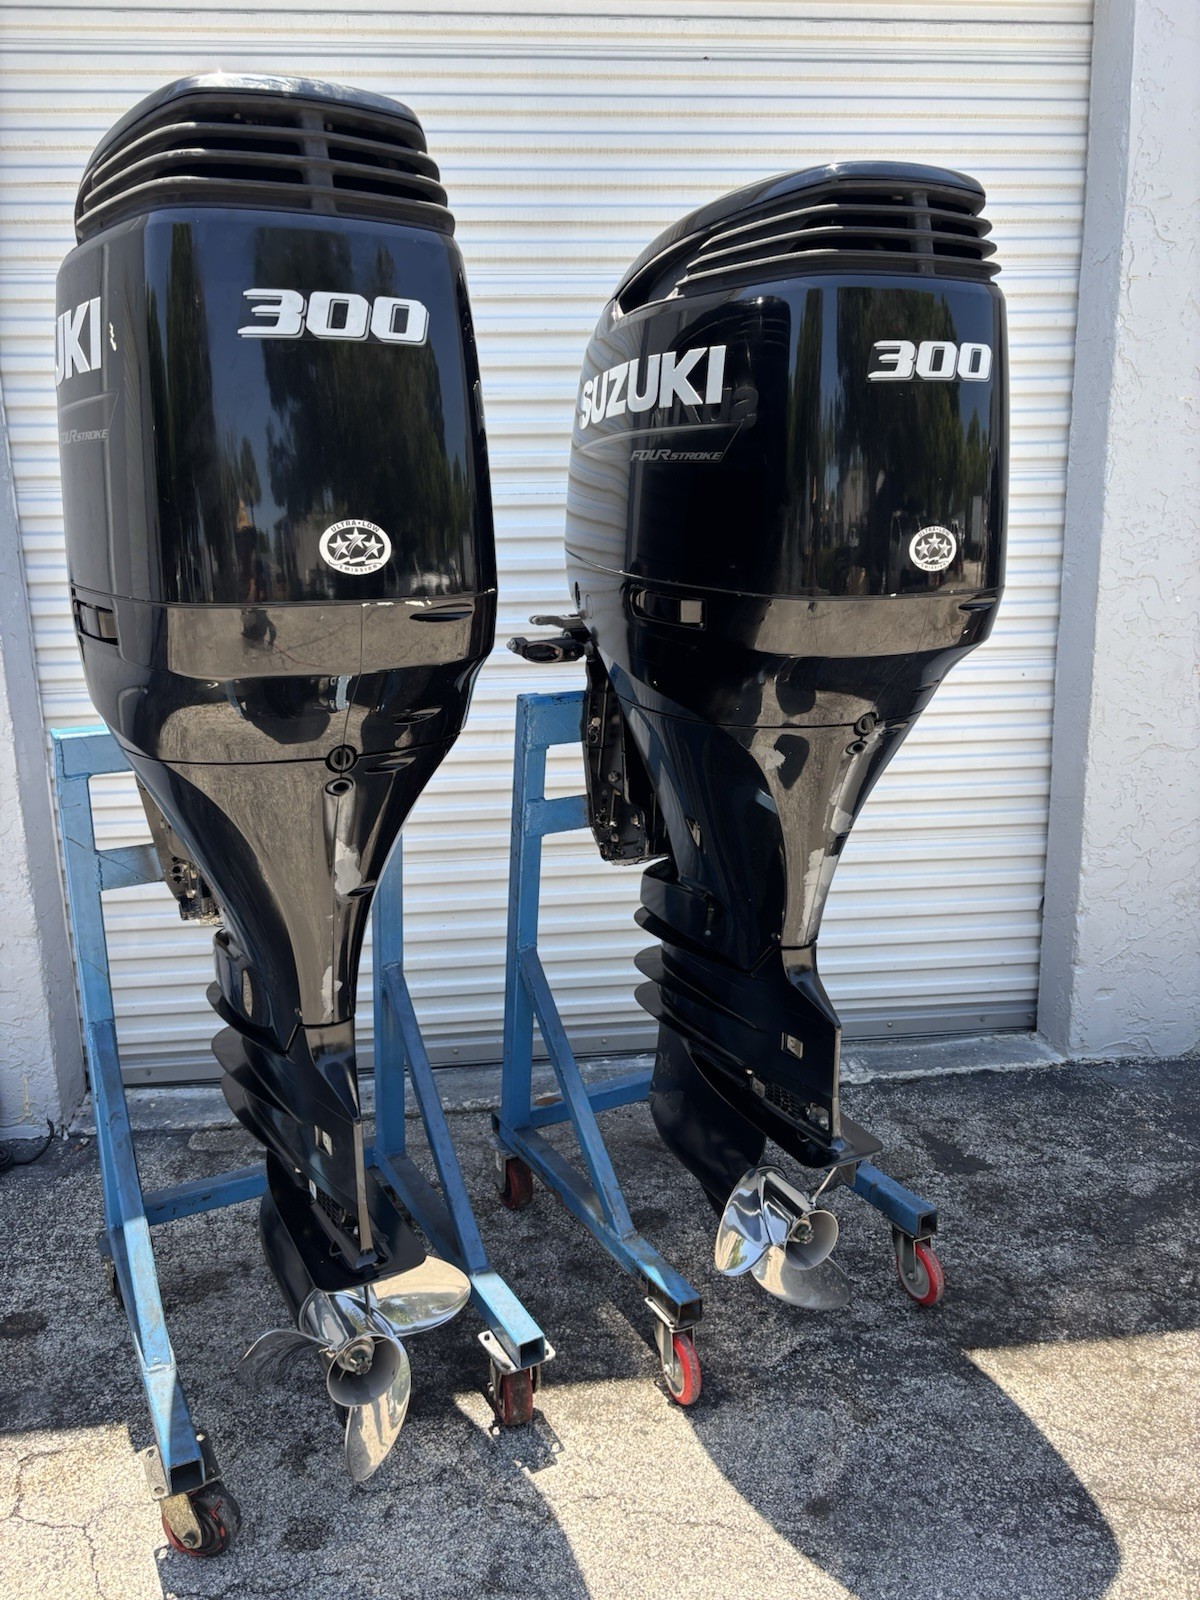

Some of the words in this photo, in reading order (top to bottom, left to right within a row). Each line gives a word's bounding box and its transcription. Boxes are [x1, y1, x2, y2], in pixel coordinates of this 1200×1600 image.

[237, 288, 430, 346] 300
[867, 340, 993, 382] 300
[578, 345, 727, 430] SUZUKI
[330, 520, 356, 533] ULTRA
[362, 521, 380, 533] LOW
